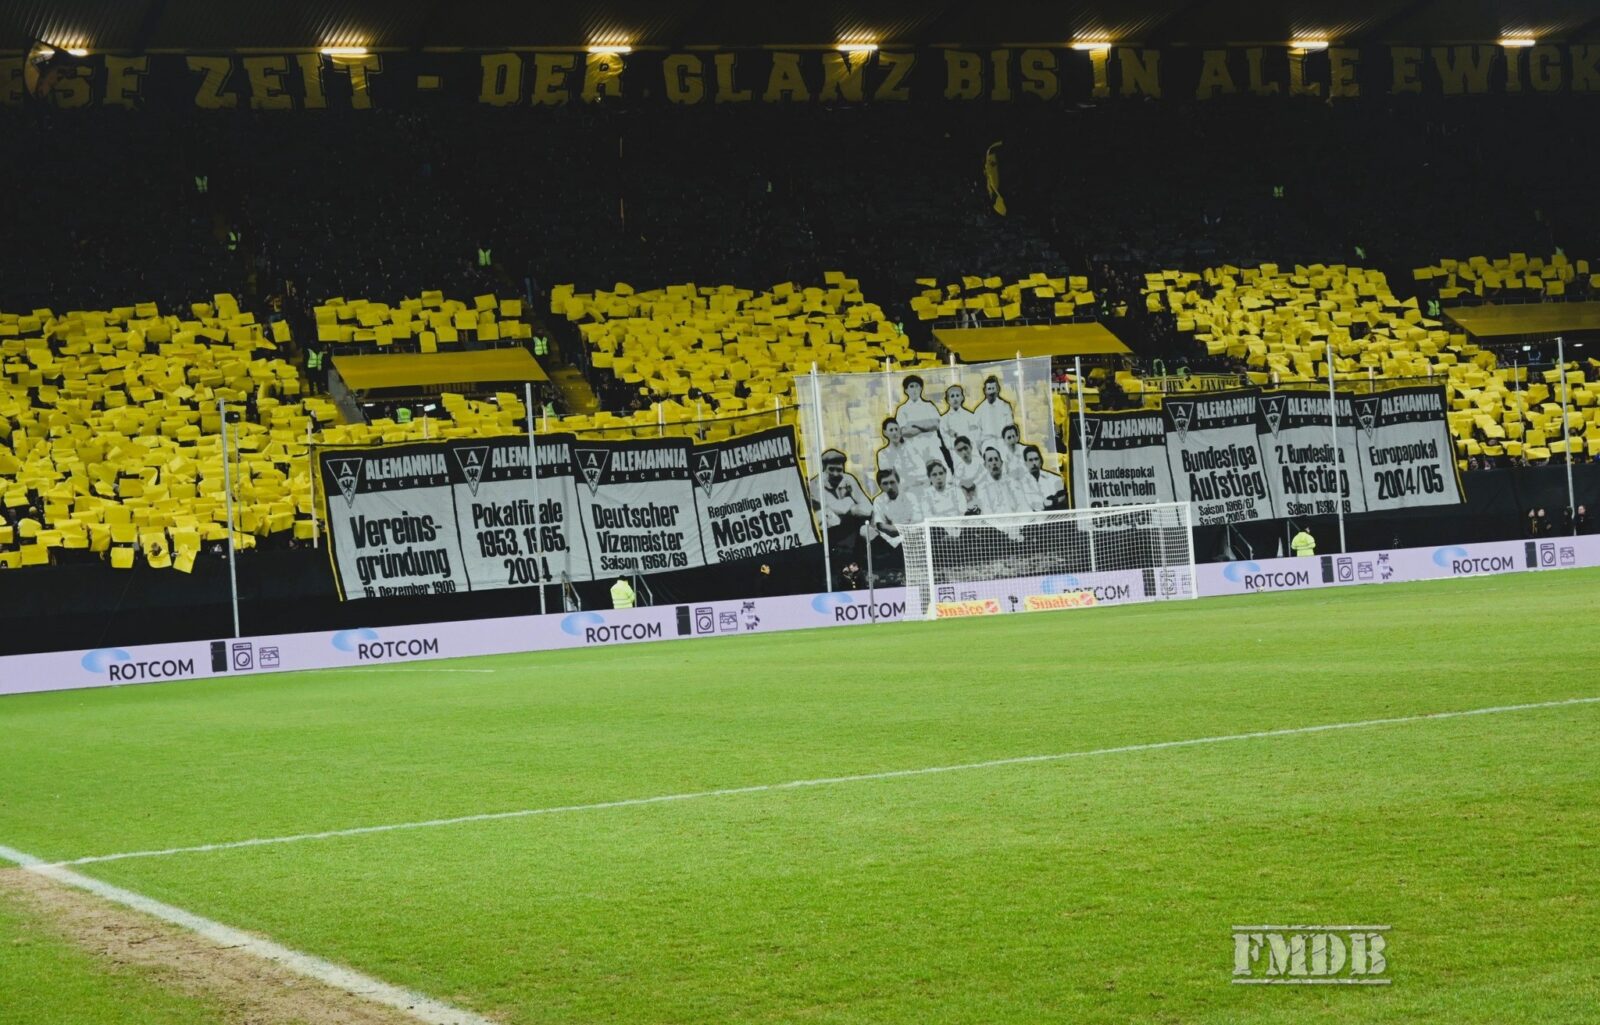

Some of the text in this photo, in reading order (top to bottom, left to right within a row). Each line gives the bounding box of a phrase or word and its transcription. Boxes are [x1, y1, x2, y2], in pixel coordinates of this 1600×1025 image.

[185, 54, 383, 110] ZEIT
[478, 52, 627, 107] DER
[662, 51, 918, 105] GLANZ
[944, 49, 1059, 101] BIS
[1089, 47, 1161, 99] IN
[1196, 46, 1360, 101] ALLE
[1288, 398, 1353, 416] ALEMANNIA
[1381, 393, 1442, 416] ALEMANNIA
[492, 443, 571, 468] ALEMANNIA
[611, 448, 688, 471] ALEMANNIA
[720, 436, 792, 470] ALEMANNIA
[1182, 443, 1258, 473] Bundesliga
[1275, 445, 1287, 464] 2.
[1369, 439, 1438, 466] Europapokal
[366, 454, 447, 480] ALEMANNIA
[1101, 465, 1155, 480] Landespokal
[367, 476, 449, 490] AACHEN
[1089, 480, 1156, 498] Mittelrhein
[1189, 468, 1266, 502] Aufstieg
[1374, 464, 1444, 500] 2004/05
[591, 502, 679, 529] Deutscher
[707, 489, 789, 519] Regionalliga West
[1198, 503, 1224, 516] Saison
[350, 511, 442, 549] Vereins-
[711, 509, 793, 549] Meister
[1199, 515, 1225, 527] Saison
[477, 528, 523, 558] 1953,
[597, 530, 684, 554] Vizemeister
[601, 551, 688, 571] Saison 1968/69
[717, 546, 753, 563] Saison
[1452, 555, 1514, 574] ROTCOM
[356, 547, 451, 586] gründung
[504, 557, 553, 585] 2004
[378, 583, 430, 597] Dezember
[432, 579, 456, 594] 1900
[1245, 571, 1309, 589] ROTCOM
[835, 601, 906, 622] ROTCOM
[1030, 595, 1080, 610] Sinalco
[586, 622, 662, 643] ROTCOM
[357, 637, 440, 660] ROTCOM
[109, 658, 195, 681] ROTCOM
